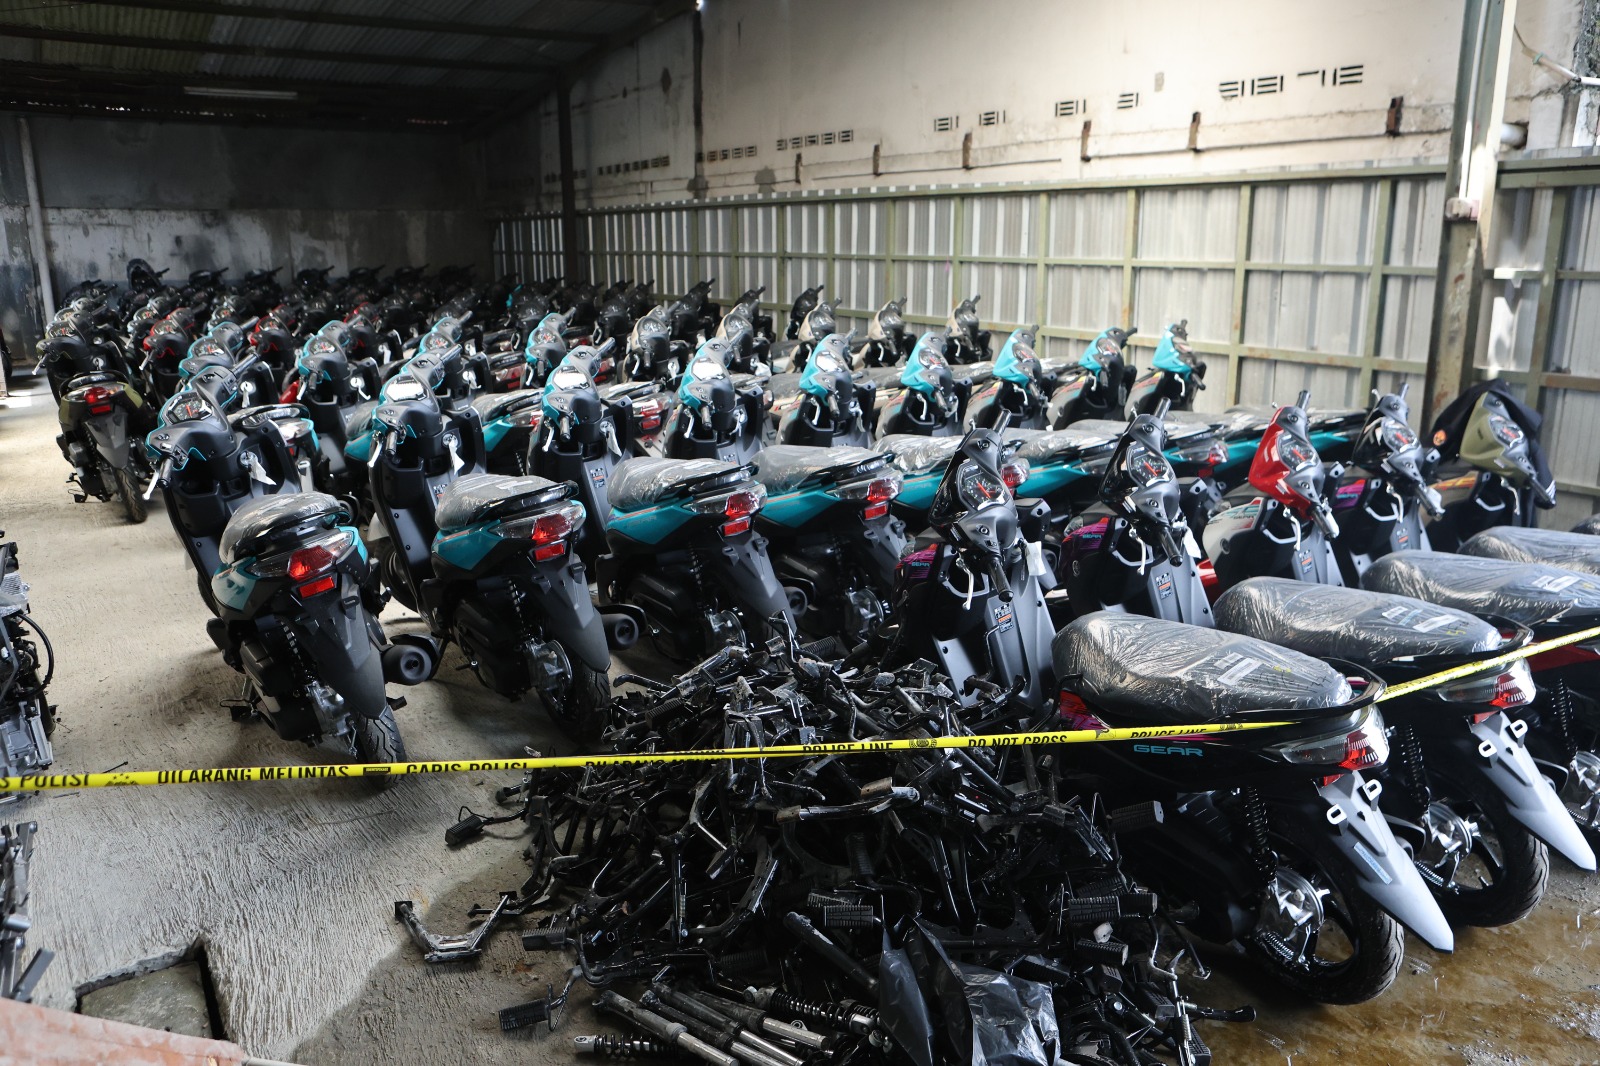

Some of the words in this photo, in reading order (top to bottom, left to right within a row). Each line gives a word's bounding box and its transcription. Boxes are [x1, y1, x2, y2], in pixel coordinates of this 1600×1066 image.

[968, 739, 987, 748] DO
[991, 737, 1018, 747] NOT
[1133, 744, 1203, 757] GEAR
[20, 773, 89, 789] POLISI
[157, 768, 252, 784] DILARANG
